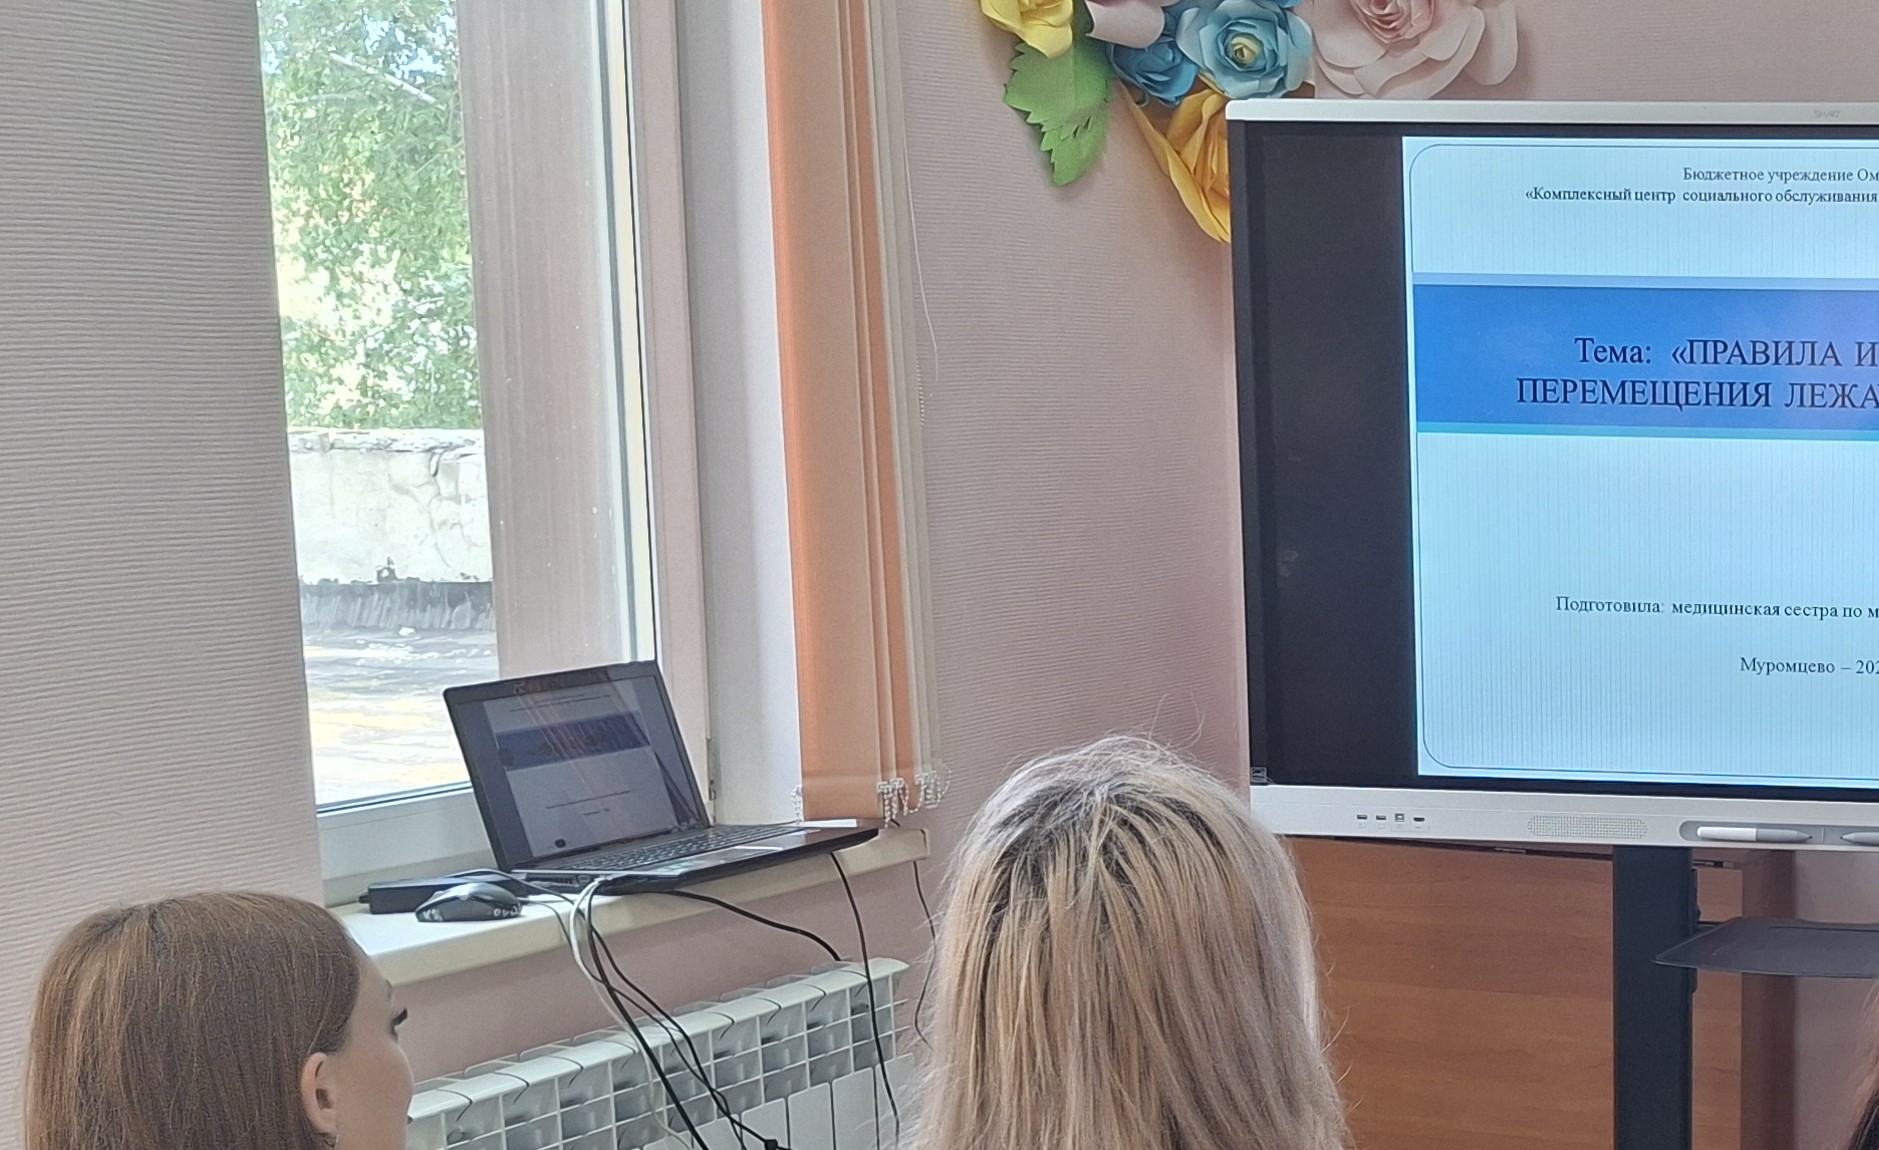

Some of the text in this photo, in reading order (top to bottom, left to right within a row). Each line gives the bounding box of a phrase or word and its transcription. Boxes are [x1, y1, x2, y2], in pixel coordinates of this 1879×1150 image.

[1682, 167, 1765, 182] Бюджетное
[1768, 171, 1853, 184] учреждение
[1525, 187, 1631, 201] «Комплексный
[1634, 192, 1676, 205] центр
[1682, 192, 1772, 204] социального
[1775, 190, 1877, 206] обслуживания
[1574, 337, 1652, 364] Тема:
[1671, 338, 1842, 367] «ПРАВИЛА
[1854, 341, 1878, 367] И
[1516, 377, 1772, 412] ПЕРЕМЕЩЕНИЯ
[1556, 596, 1664, 614] Подготовила:
[1671, 601, 1781, 616] медицинская
[1784, 605, 1838, 621] сестра
[1842, 607, 1862, 618] по
[1740, 657, 1835, 675] Муромцево
